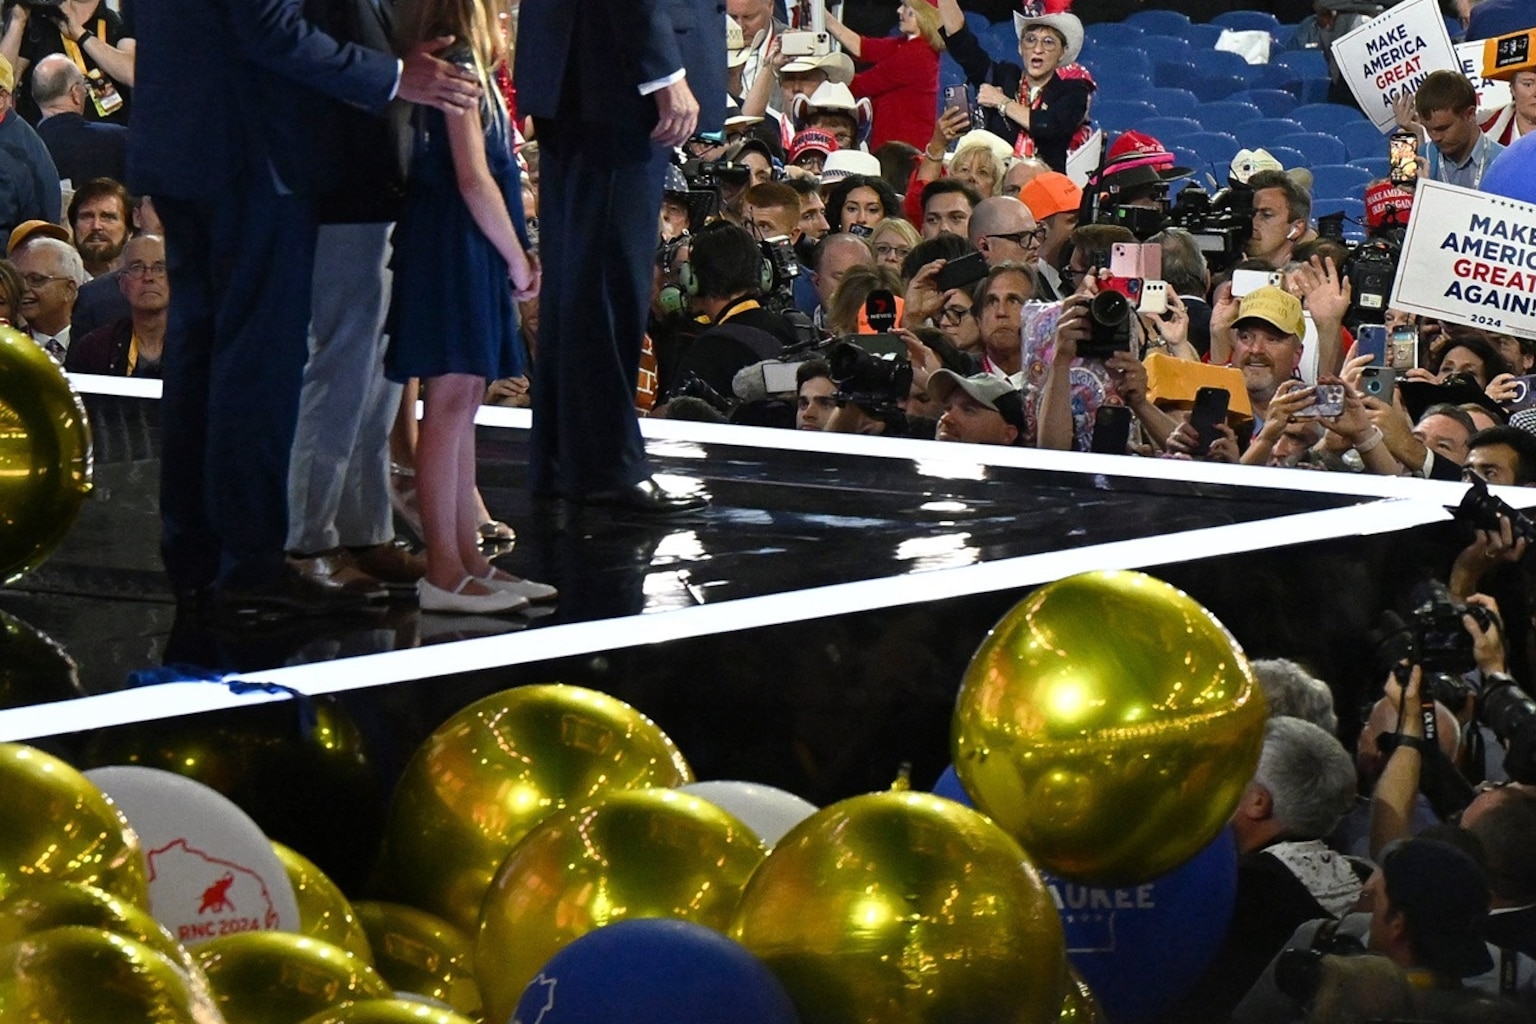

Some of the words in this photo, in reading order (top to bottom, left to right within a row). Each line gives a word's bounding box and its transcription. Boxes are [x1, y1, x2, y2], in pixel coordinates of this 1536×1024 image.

[1365, 24, 1408, 56] MAKE
[1362, 35, 1428, 79] AMERICA
[1375, 56, 1423, 90] GREAT
[1470, 313, 1503, 328] 2024
